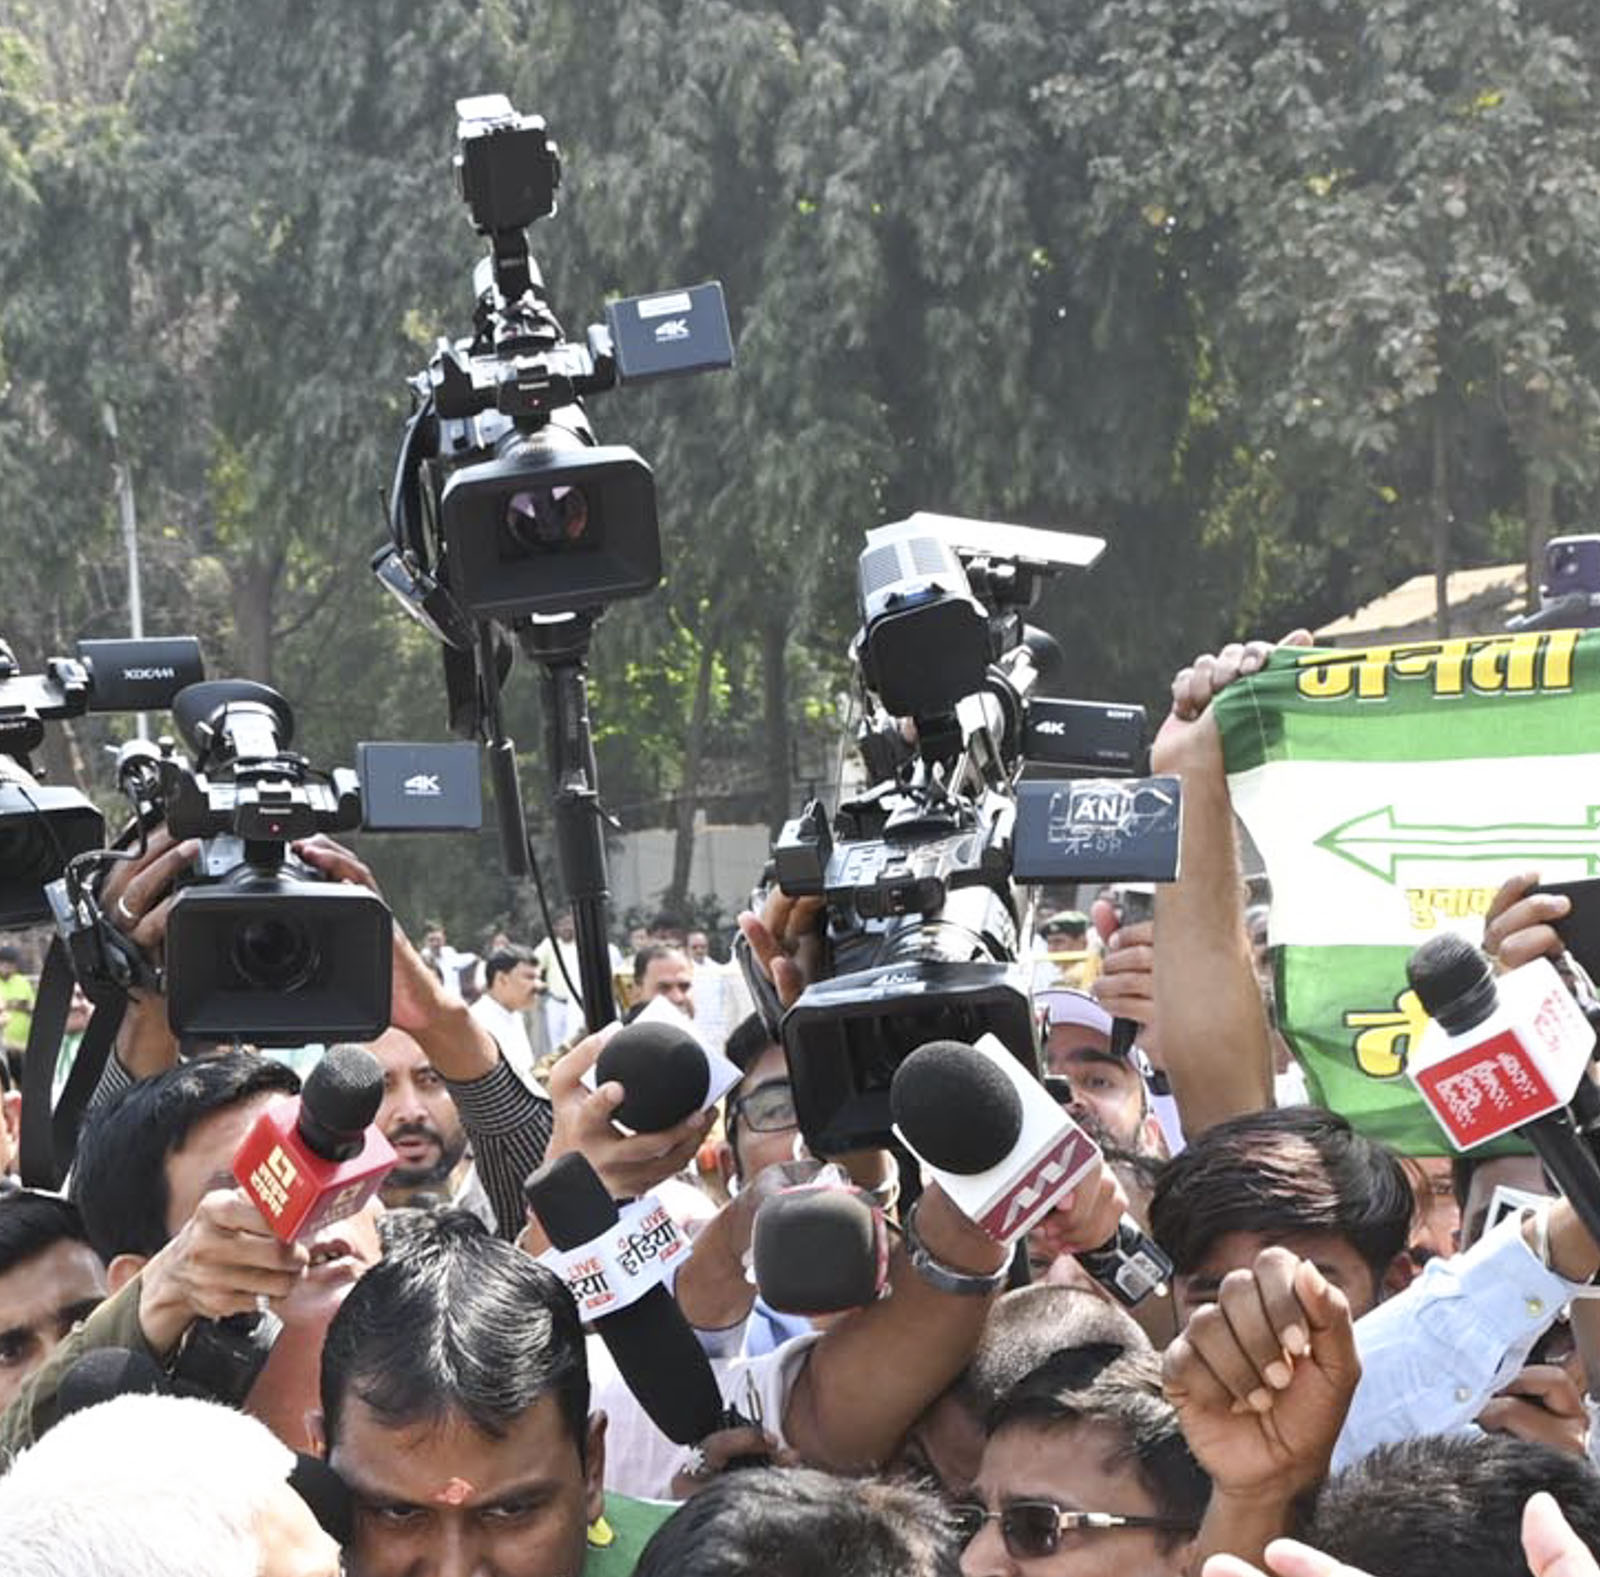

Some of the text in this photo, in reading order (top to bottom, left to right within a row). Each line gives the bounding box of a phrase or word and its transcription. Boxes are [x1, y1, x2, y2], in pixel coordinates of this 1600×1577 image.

[655, 319, 689, 337] 4K
[1298, 628, 1580, 702] जनता
[1035, 720, 1066, 736] 4K
[404, 774, 441, 792] 4K
[1437, 1053, 1537, 1127] PTI
[640, 1206, 668, 1232] LIVE
[568, 1257, 602, 1279] LIVE
